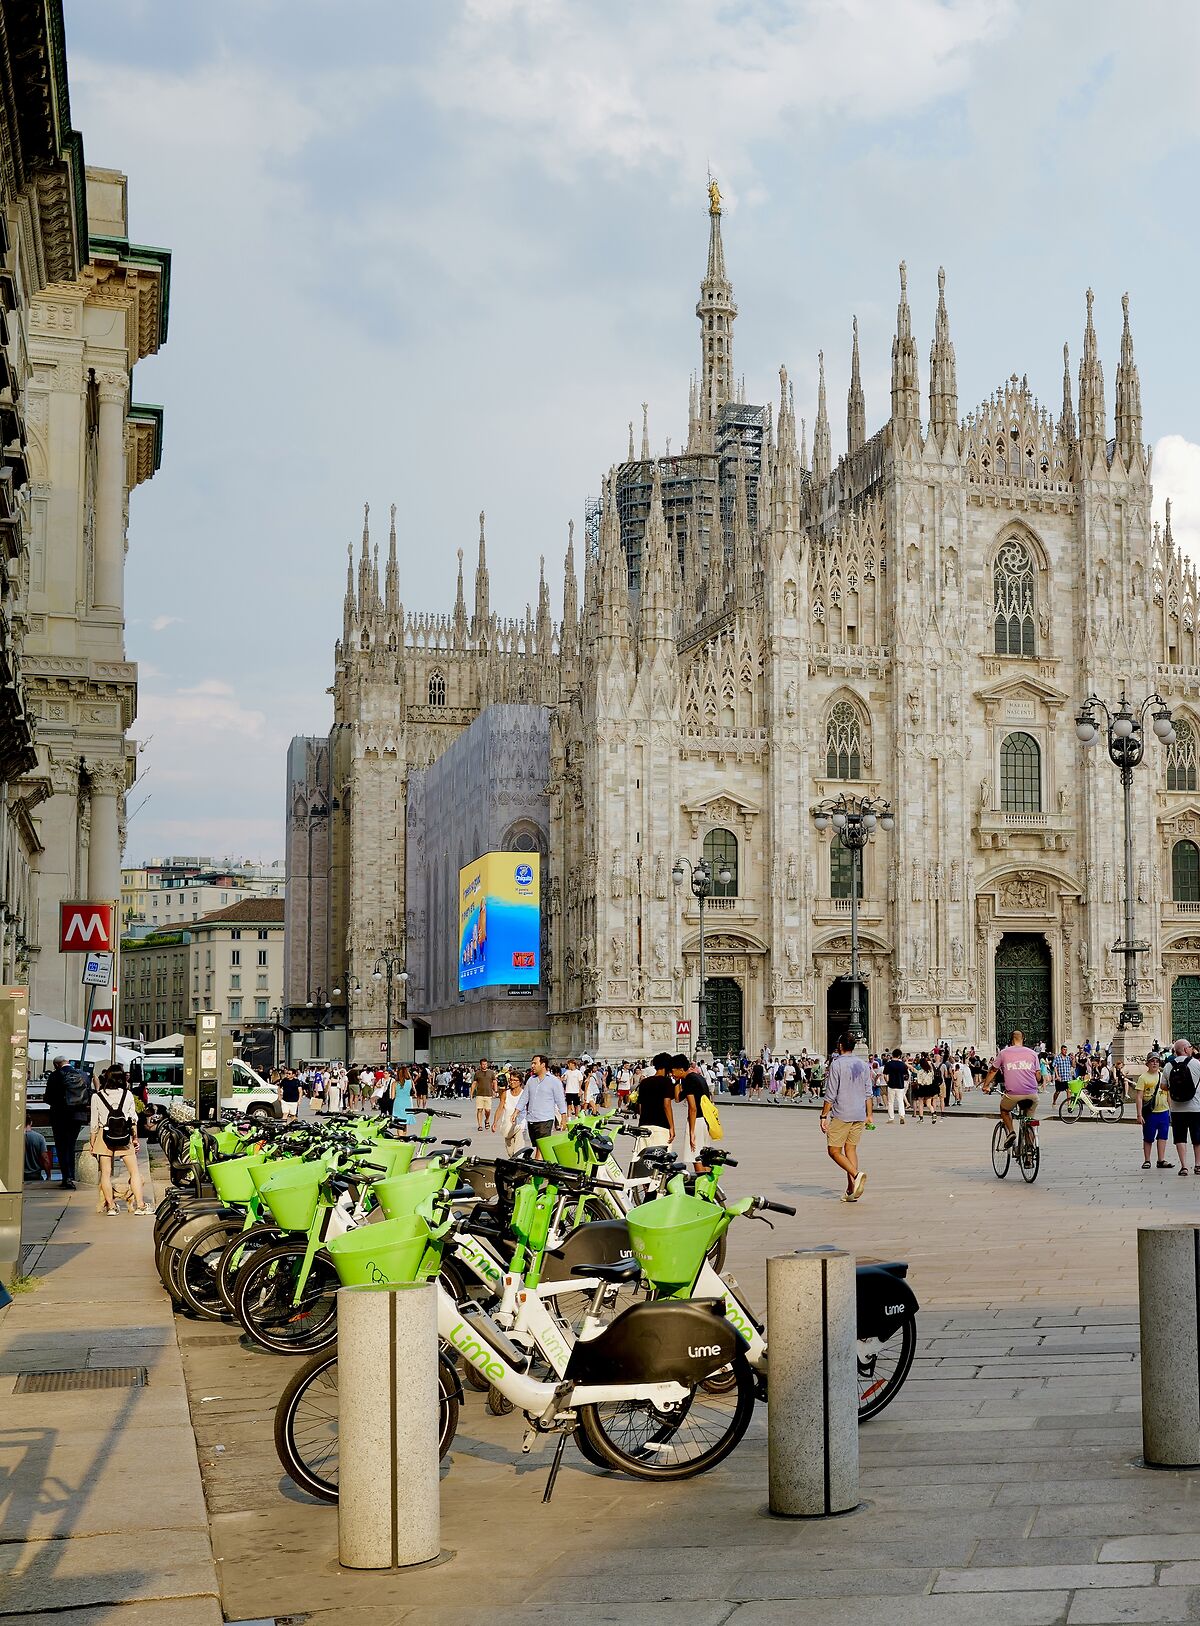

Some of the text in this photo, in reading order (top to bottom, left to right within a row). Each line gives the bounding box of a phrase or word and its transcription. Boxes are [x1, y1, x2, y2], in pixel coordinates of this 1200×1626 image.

[65, 913, 109, 941] M
[93, 1014, 112, 1027] M
[678, 1022, 690, 1033] M
[620, 1250, 633, 1258] Lim
[885, 1303, 905, 1316] Lime
[449, 1323, 505, 1382] Lime
[687, 1344, 722, 1358] Lime
